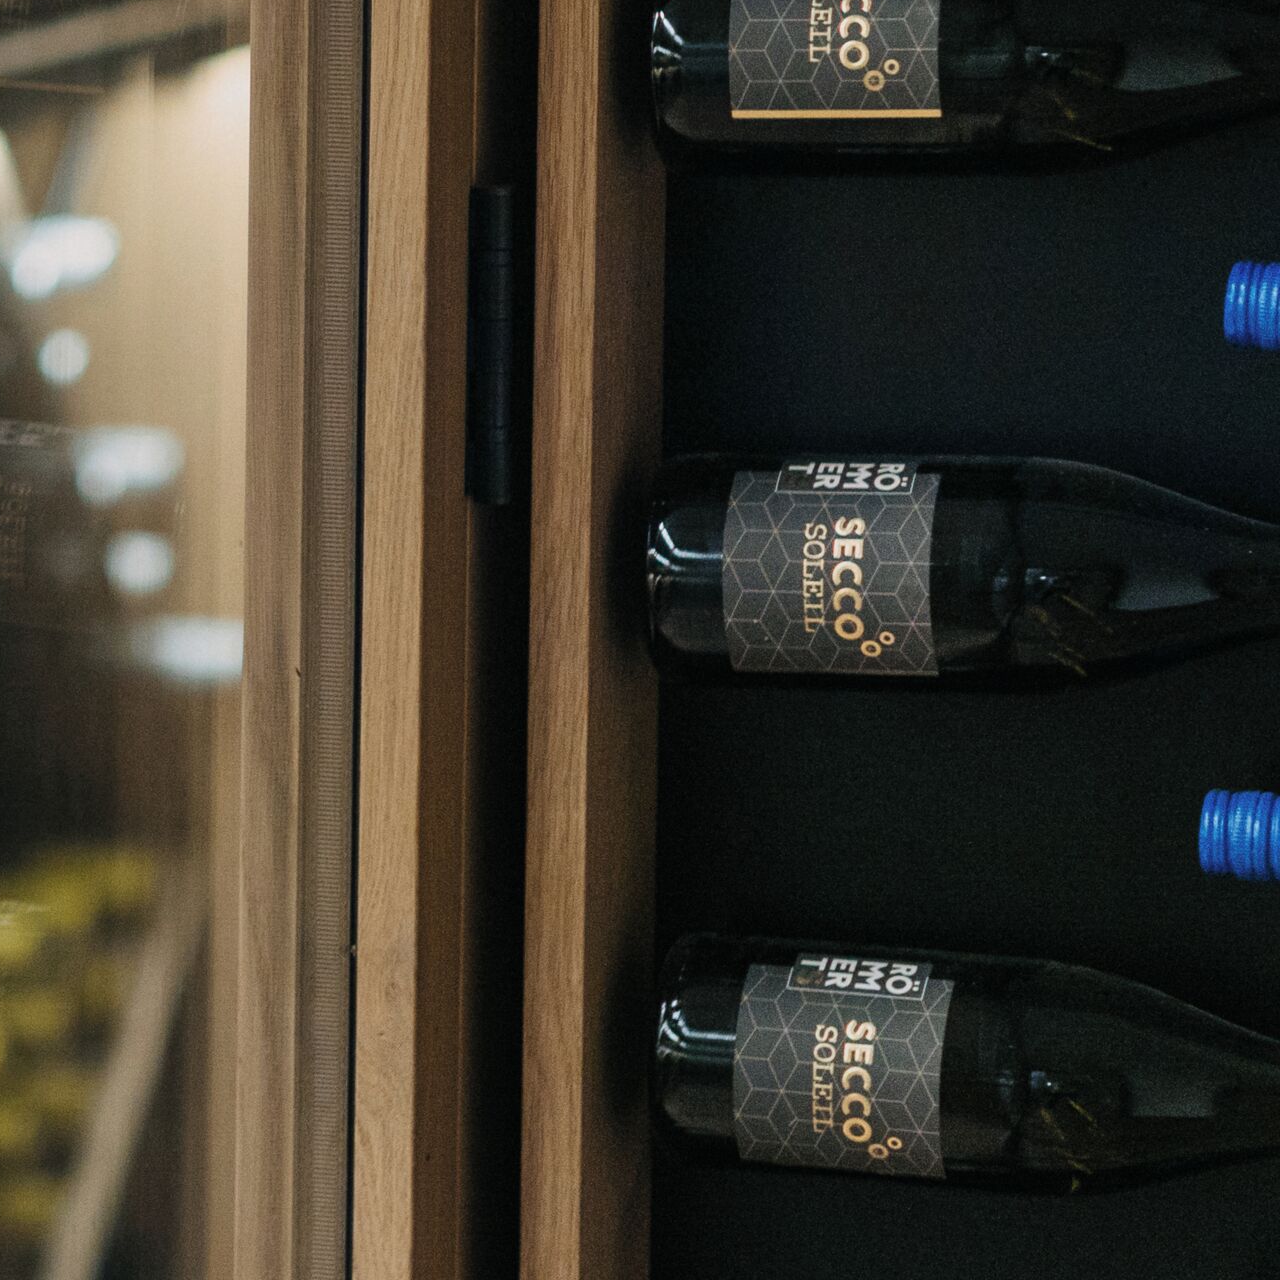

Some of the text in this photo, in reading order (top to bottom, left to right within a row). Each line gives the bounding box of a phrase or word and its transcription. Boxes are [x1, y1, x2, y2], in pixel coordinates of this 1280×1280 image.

[802, 522, 828, 633] SOLEIL
[832, 516, 866, 641] SECCO
[812, 1023, 840, 1134] SOLEIL
[842, 1019, 877, 1143] SECCO
